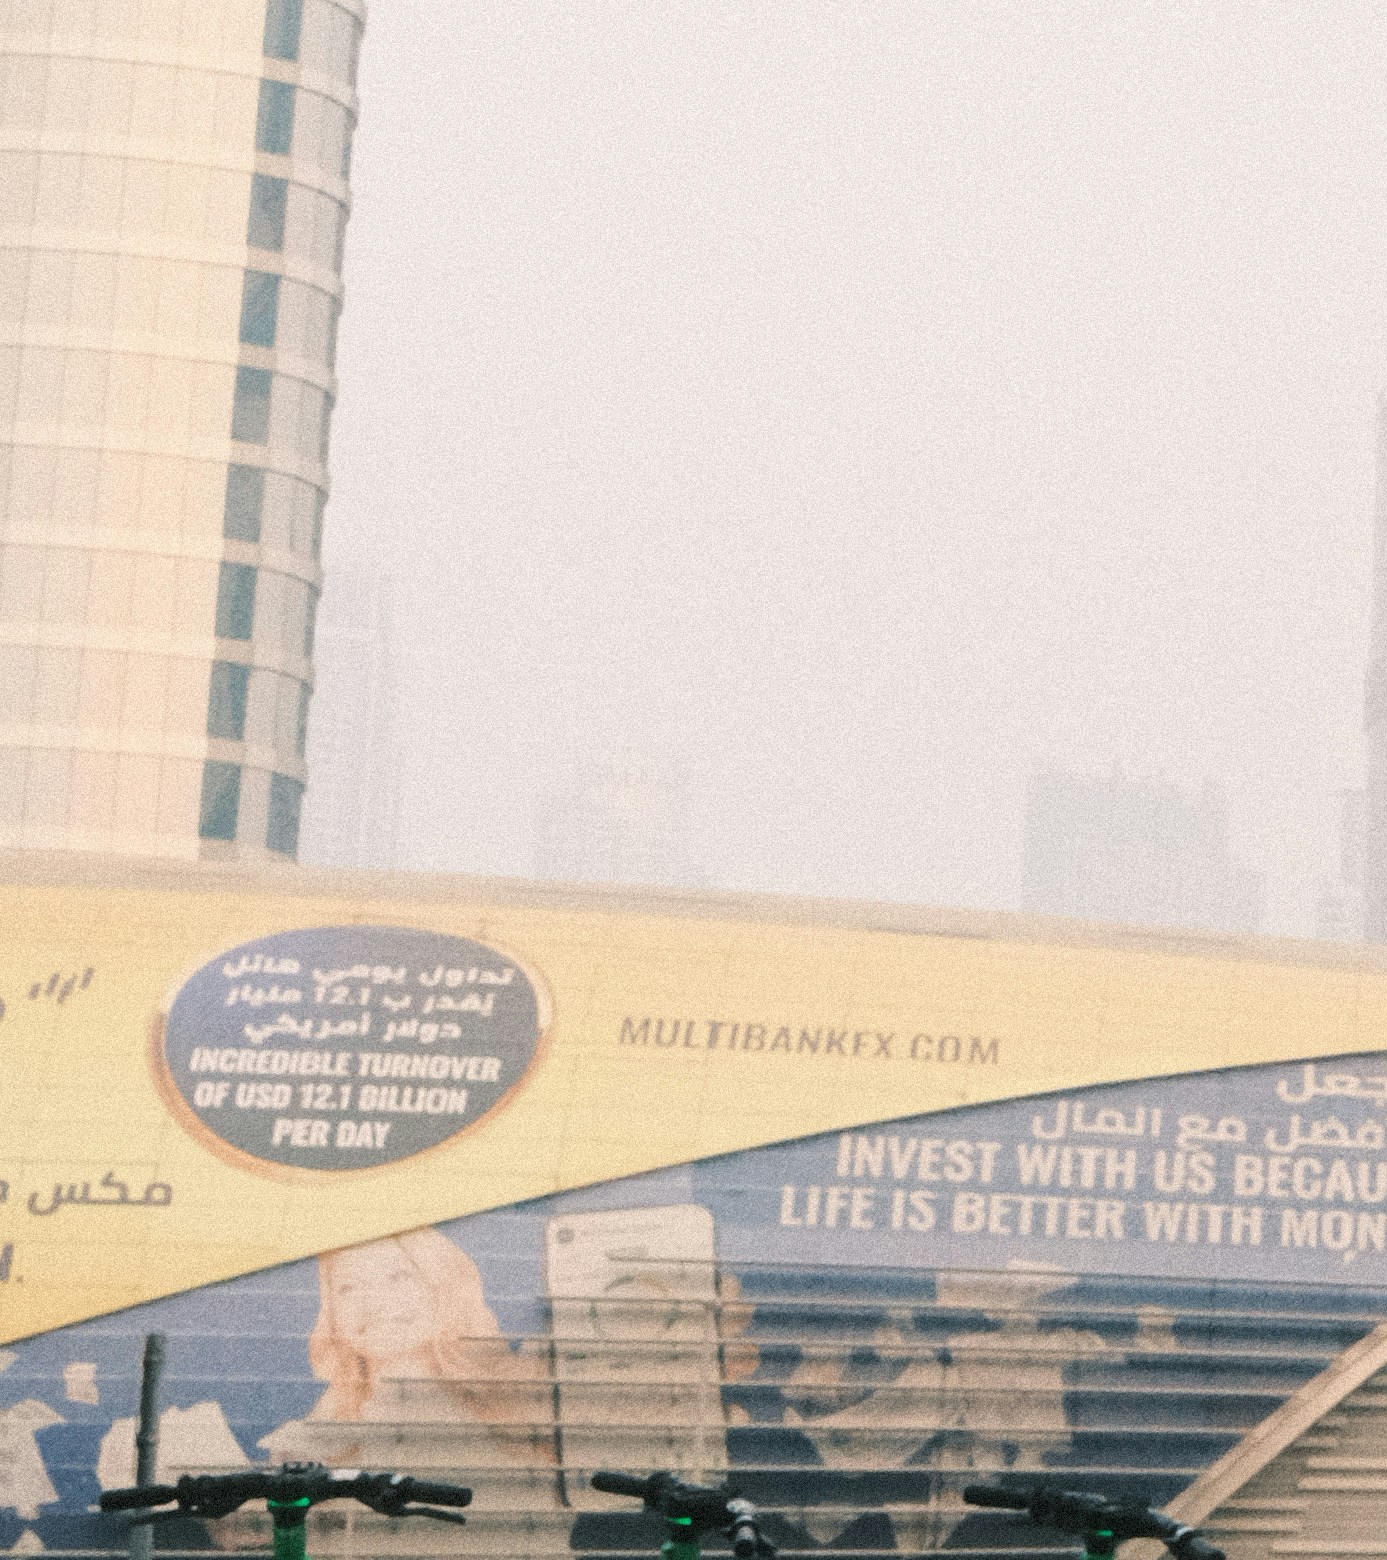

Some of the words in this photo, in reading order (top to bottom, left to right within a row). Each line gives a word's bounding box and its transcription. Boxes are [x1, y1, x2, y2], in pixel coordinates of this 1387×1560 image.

[313, 985, 371, 1006] 12.1
[189, 1046, 351, 1077] INCREDIBLE
[358, 1051, 504, 1083] TURNOVER
[194, 1081, 230, 1109] OF
[235, 1081, 290, 1110] USD
[300, 1082, 350, 1111] 12.1
[358, 1084, 469, 1114] BILLION
[271, 1117, 331, 1148] PER
[335, 1120, 393, 1148] DAY
[1031, 1100, 1162, 1142] المال
[1175, 1116, 1248, 1149] مع
[836, 1133, 1000, 1184] INVEST
[1016, 1141, 1137, 1192] WITH
[1154, 1149, 1218, 1195] US
[780, 1184, 874, 1230] LIFE
[891, 1188, 935, 1232] IS
[950, 1191, 1124, 1242] BETTER
[1143, 1202, 1266, 1247] WITH
